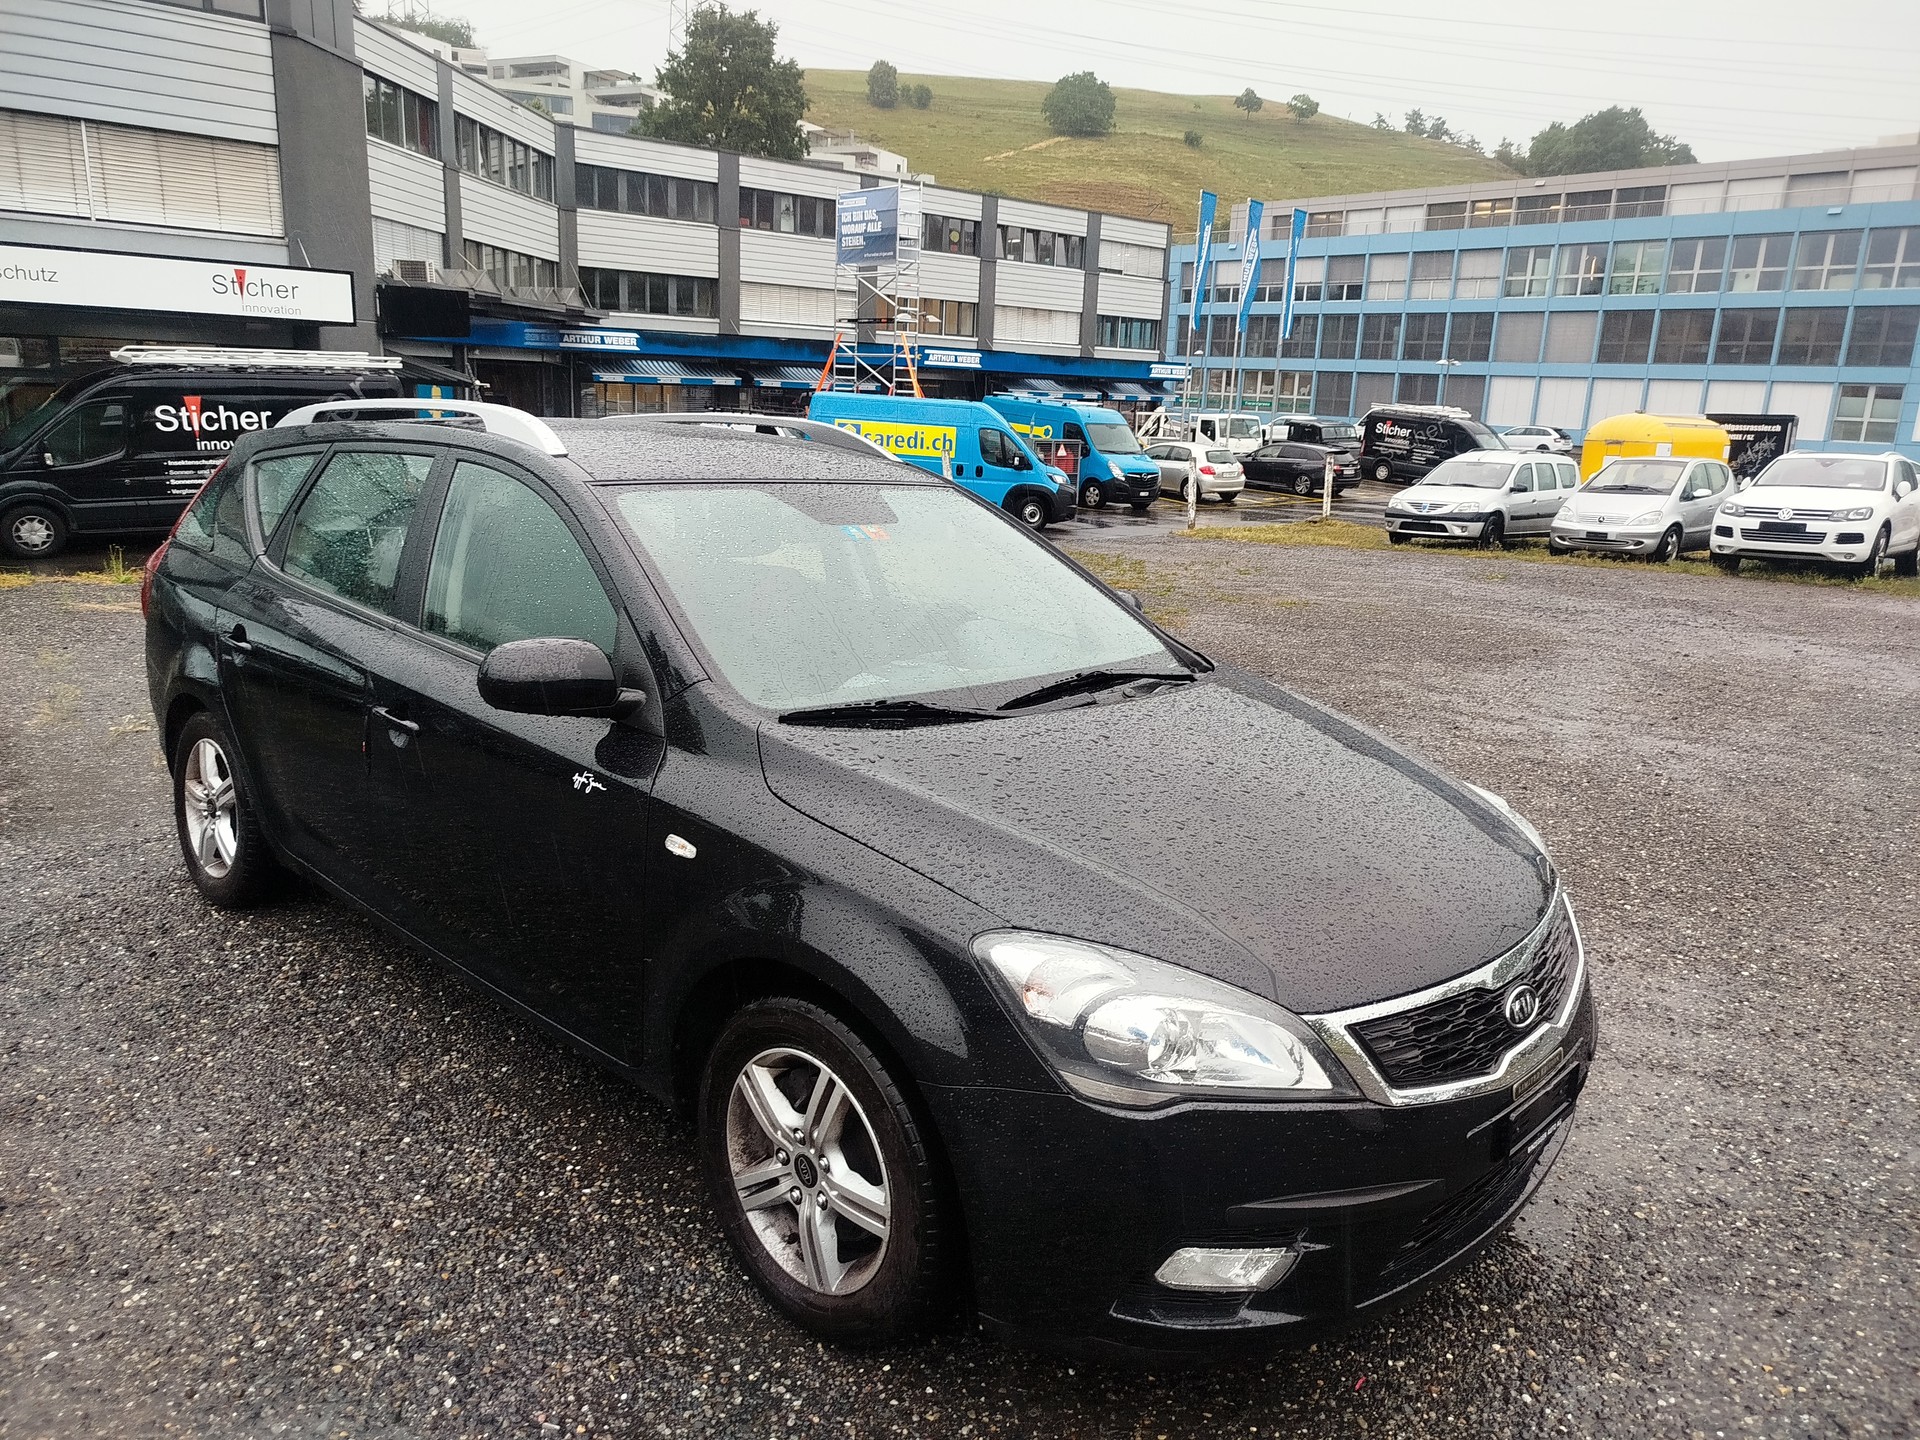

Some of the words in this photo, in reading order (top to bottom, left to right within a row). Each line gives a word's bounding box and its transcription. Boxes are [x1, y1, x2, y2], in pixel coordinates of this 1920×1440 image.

[0, 264, 59, 283] chutz
[212, 274, 299, 300] Sticher
[242, 304, 302, 316] innovation
[562, 334, 601, 344] ARTHUR
[603, 336, 637, 346] WEBER
[928, 354, 955, 362] ARTHUR
[957, 356, 980, 364] WEBER
[154, 405, 272, 432] Sticher
[1375, 422, 1412, 437] Sticher
[864, 431, 953, 452] saredi.ch
